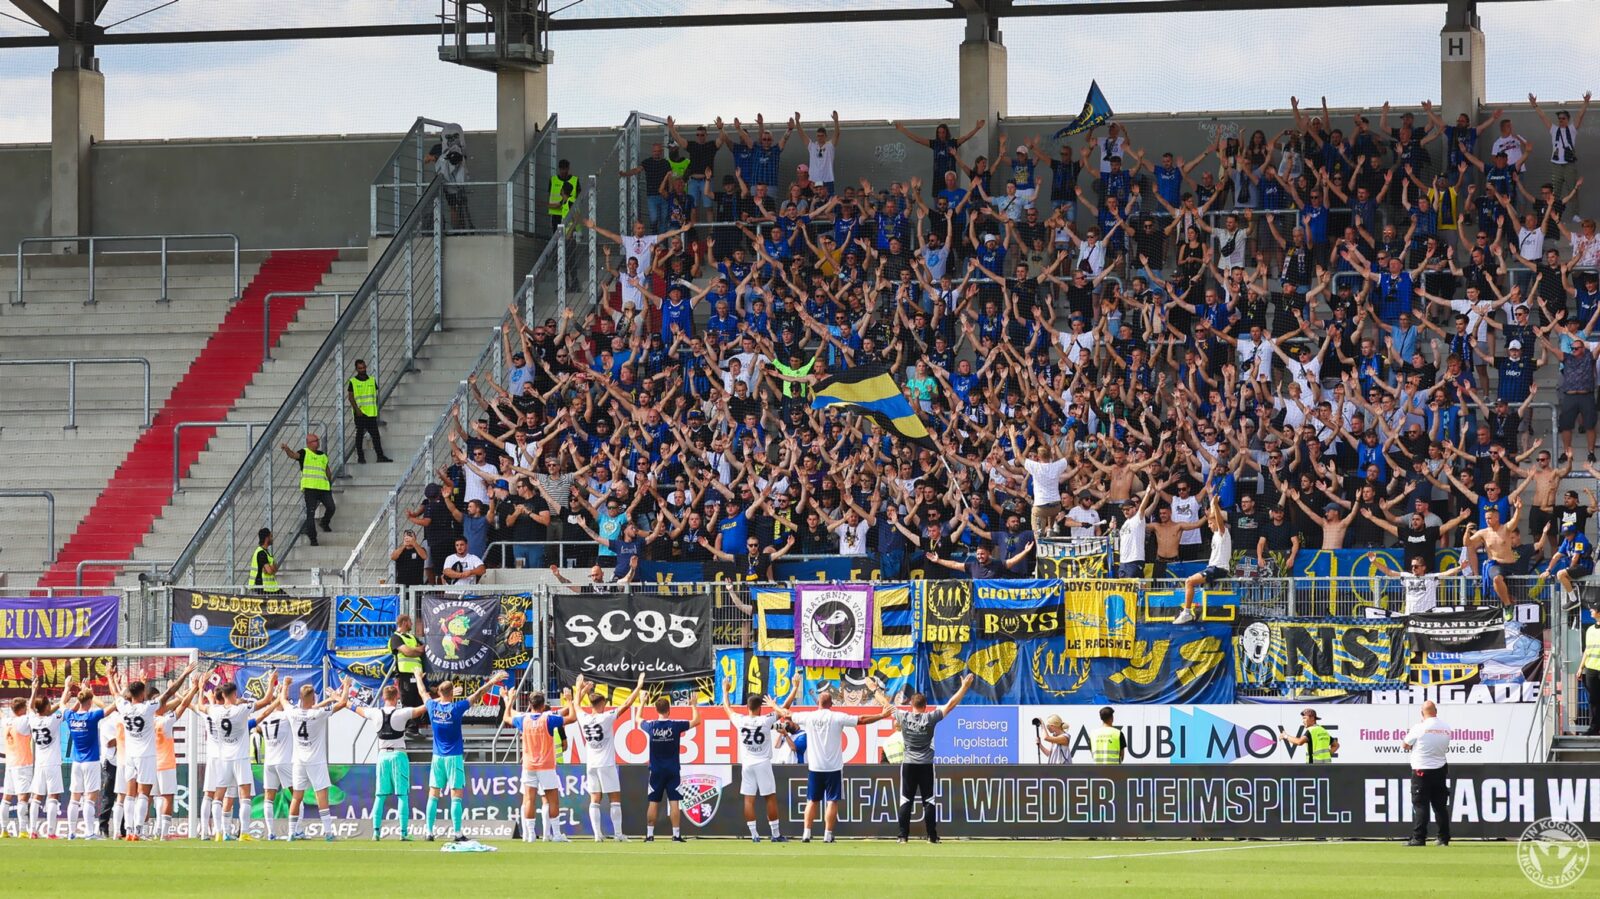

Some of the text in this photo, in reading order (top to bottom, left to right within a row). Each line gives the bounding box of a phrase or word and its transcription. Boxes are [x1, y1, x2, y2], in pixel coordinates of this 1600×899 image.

[1448, 37, 1463, 56] H
[565, 610, 699, 648] SC95
[926, 625, 971, 643] BOYS
[1068, 640, 1132, 651] LE RACISME
[581, 656, 684, 672] Saarbrücken
[124, 716, 146, 732] 39
[221, 718, 232, 737] 9
[262, 719, 281, 740] 17
[298, 721, 309, 740] 4
[957, 718, 1008, 736] Parsberg
[740, 726, 766, 745] 26
[1071, 725, 1186, 758] AUBI
[1360, 729, 1390, 740] Finde
[953, 736, 1008, 754] Ingolstadt
[963, 778, 1116, 822] WIEDER
[1127, 778, 1352, 822] HEIMSPIEL.
